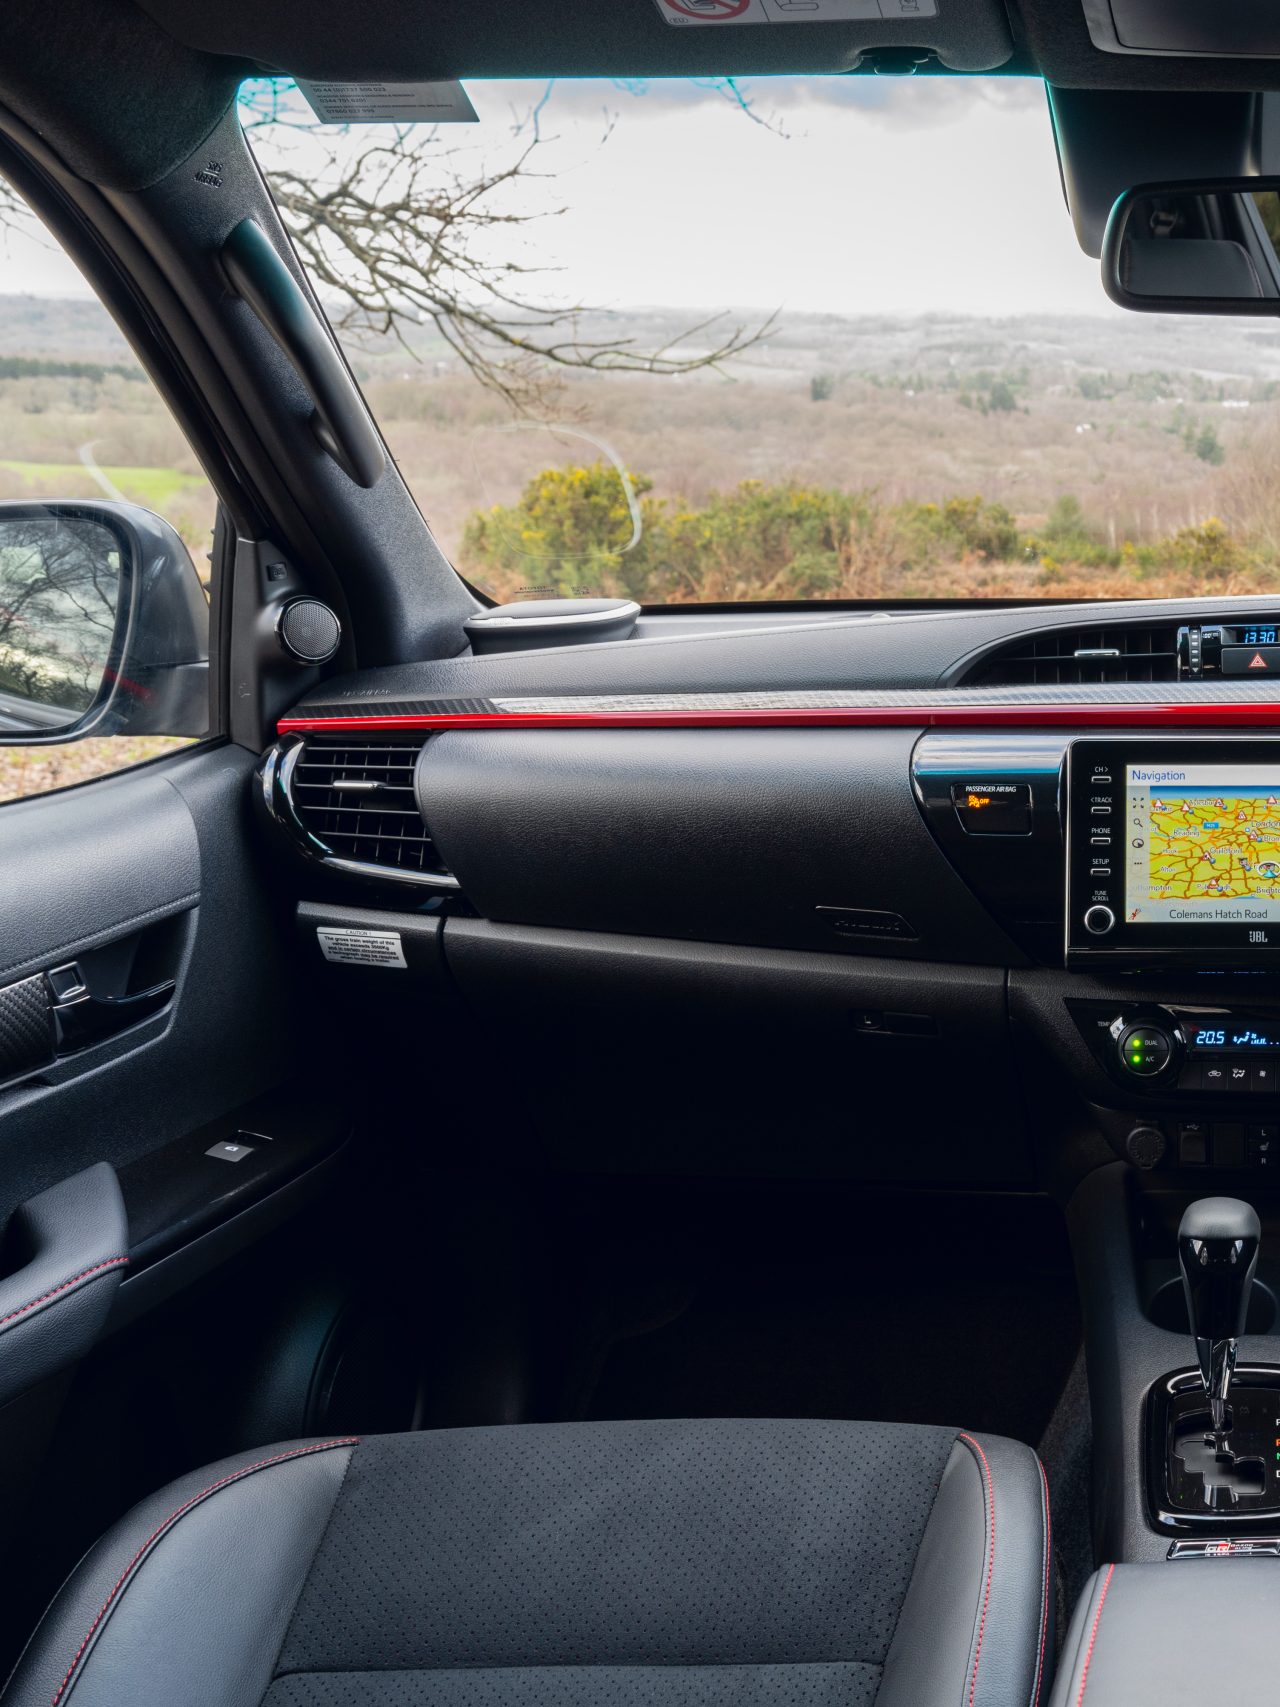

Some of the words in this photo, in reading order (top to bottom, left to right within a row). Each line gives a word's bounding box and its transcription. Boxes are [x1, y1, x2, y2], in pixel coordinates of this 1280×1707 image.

[1132, 770, 1186, 783] Navigation
[1251, 820, 1280, 828] London
[1173, 829, 1200, 837] Reading
[1169, 909, 1213, 919] Colemans
[1215, 909, 1242, 919] Hatch
[1244, 909, 1268, 919] Road
[1249, 931, 1268, 943] JBL
[1196, 1031, 1225, 1044] 20.5
[1145, 1055, 1155, 1063] A/C
